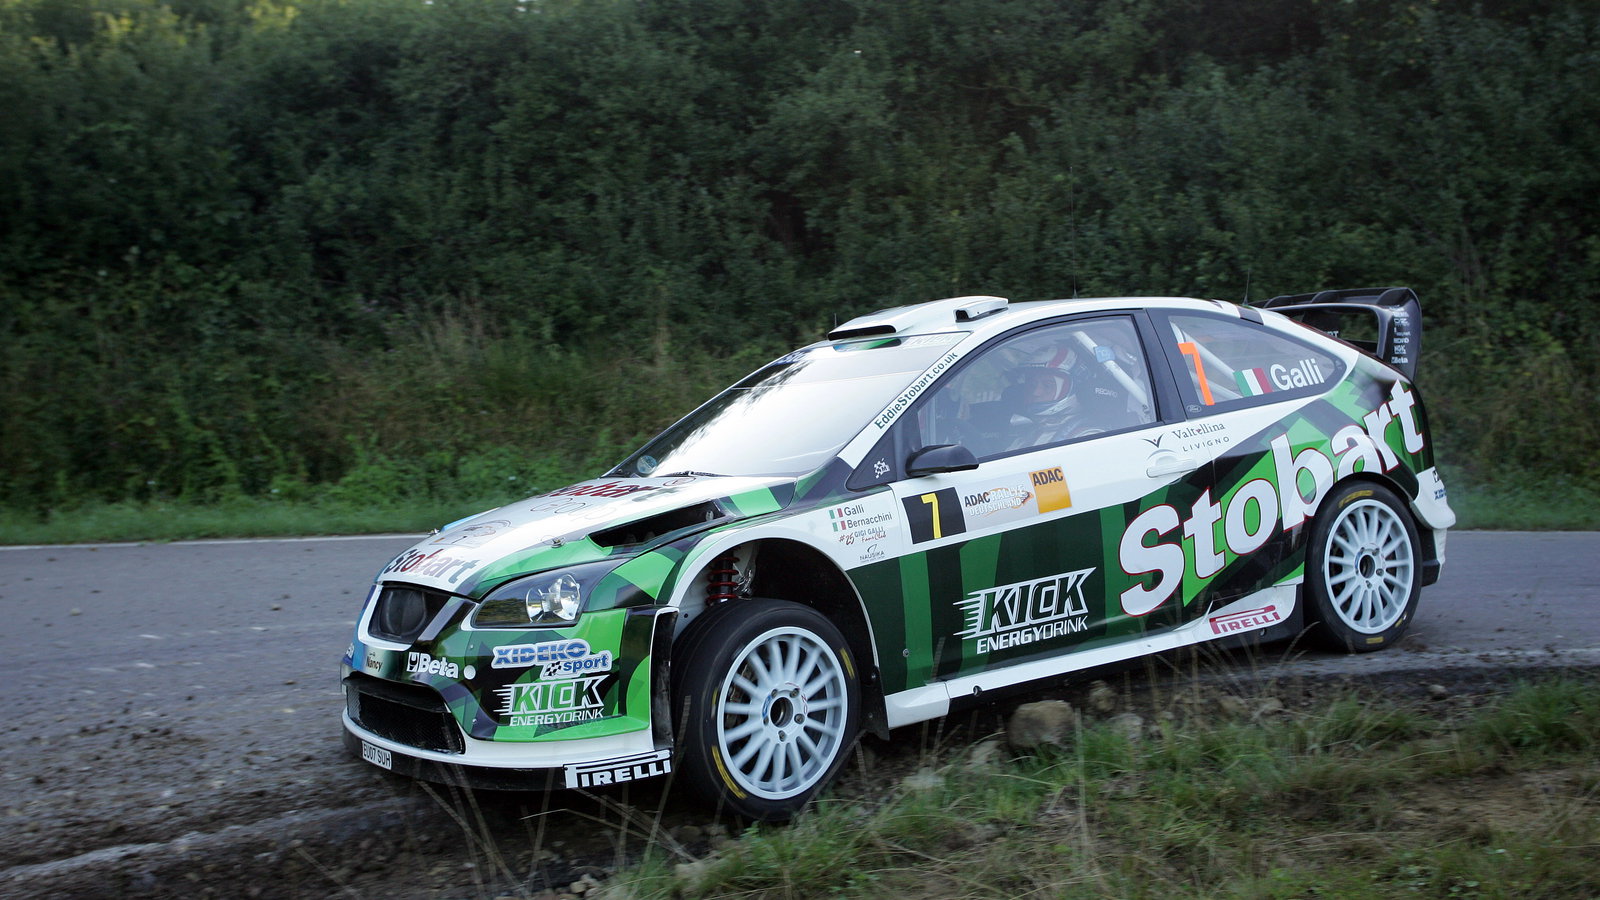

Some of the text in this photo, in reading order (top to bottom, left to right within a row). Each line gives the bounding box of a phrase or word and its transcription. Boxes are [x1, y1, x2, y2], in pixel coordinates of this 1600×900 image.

[1178, 342, 1215, 406] 7
[1270, 358, 1325, 391] Galli
[874, 351, 958, 430] EddieStobart.co.uk
[1172, 421, 1225, 440] Valtellina
[1182, 436, 1230, 452] LIVIGNO
[1033, 468, 1064, 487] ADAC
[964, 485, 1028, 507] ADAC RALLYE
[969, 497, 1021, 516] DEUTSCHLAND
[1118, 378, 1424, 617] Stobart
[844, 504, 865, 516] Galli
[847, 512, 892, 529] Bernacchini
[921, 493, 942, 539] 7
[854, 526, 884, 538] GIGI GALLI
[384, 548, 480, 584] Stobart
[973, 567, 1096, 637] KICK
[1209, 604, 1280, 635] PIRELLI
[976, 616, 1088, 655] ENERGYDRINK
[366, 655, 383, 672] Nancy
[418, 653, 459, 679] Beta
[493, 641, 588, 666] XIDEKO
[563, 655, 609, 673] sport
[505, 674, 610, 715] KICK
[509, 708, 604, 727] ENERGYDRINK
[363, 749, 391, 767] EU07 SUH
[564, 749, 672, 789] PIRELLI
